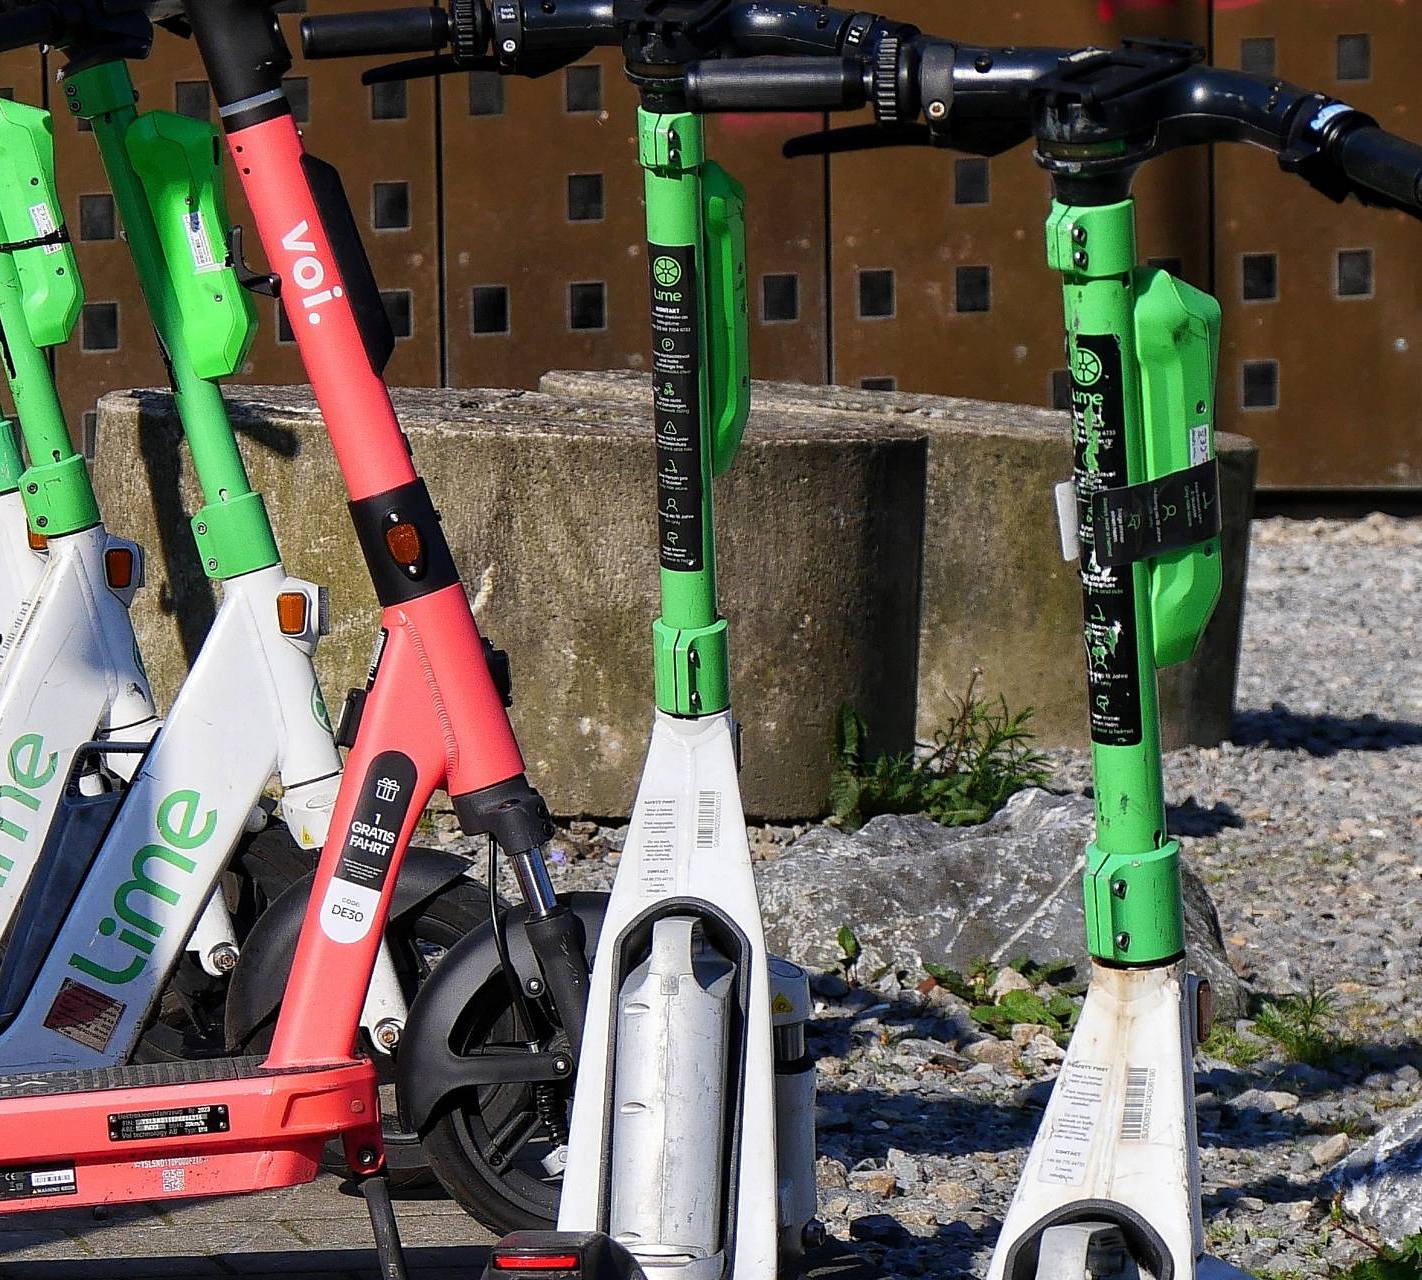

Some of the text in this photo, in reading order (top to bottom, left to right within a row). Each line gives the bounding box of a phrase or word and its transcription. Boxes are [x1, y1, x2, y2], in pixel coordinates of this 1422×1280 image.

[281, 219, 343, 325] voi.
[653, 287, 683, 302] Lime
[374, 813, 381, 825] 1
[351, 821, 396, 844] GRATIS
[349, 834, 390, 856] FAHRT
[67, 789, 218, 985] Lime
[331, 904, 364, 922] DE30
